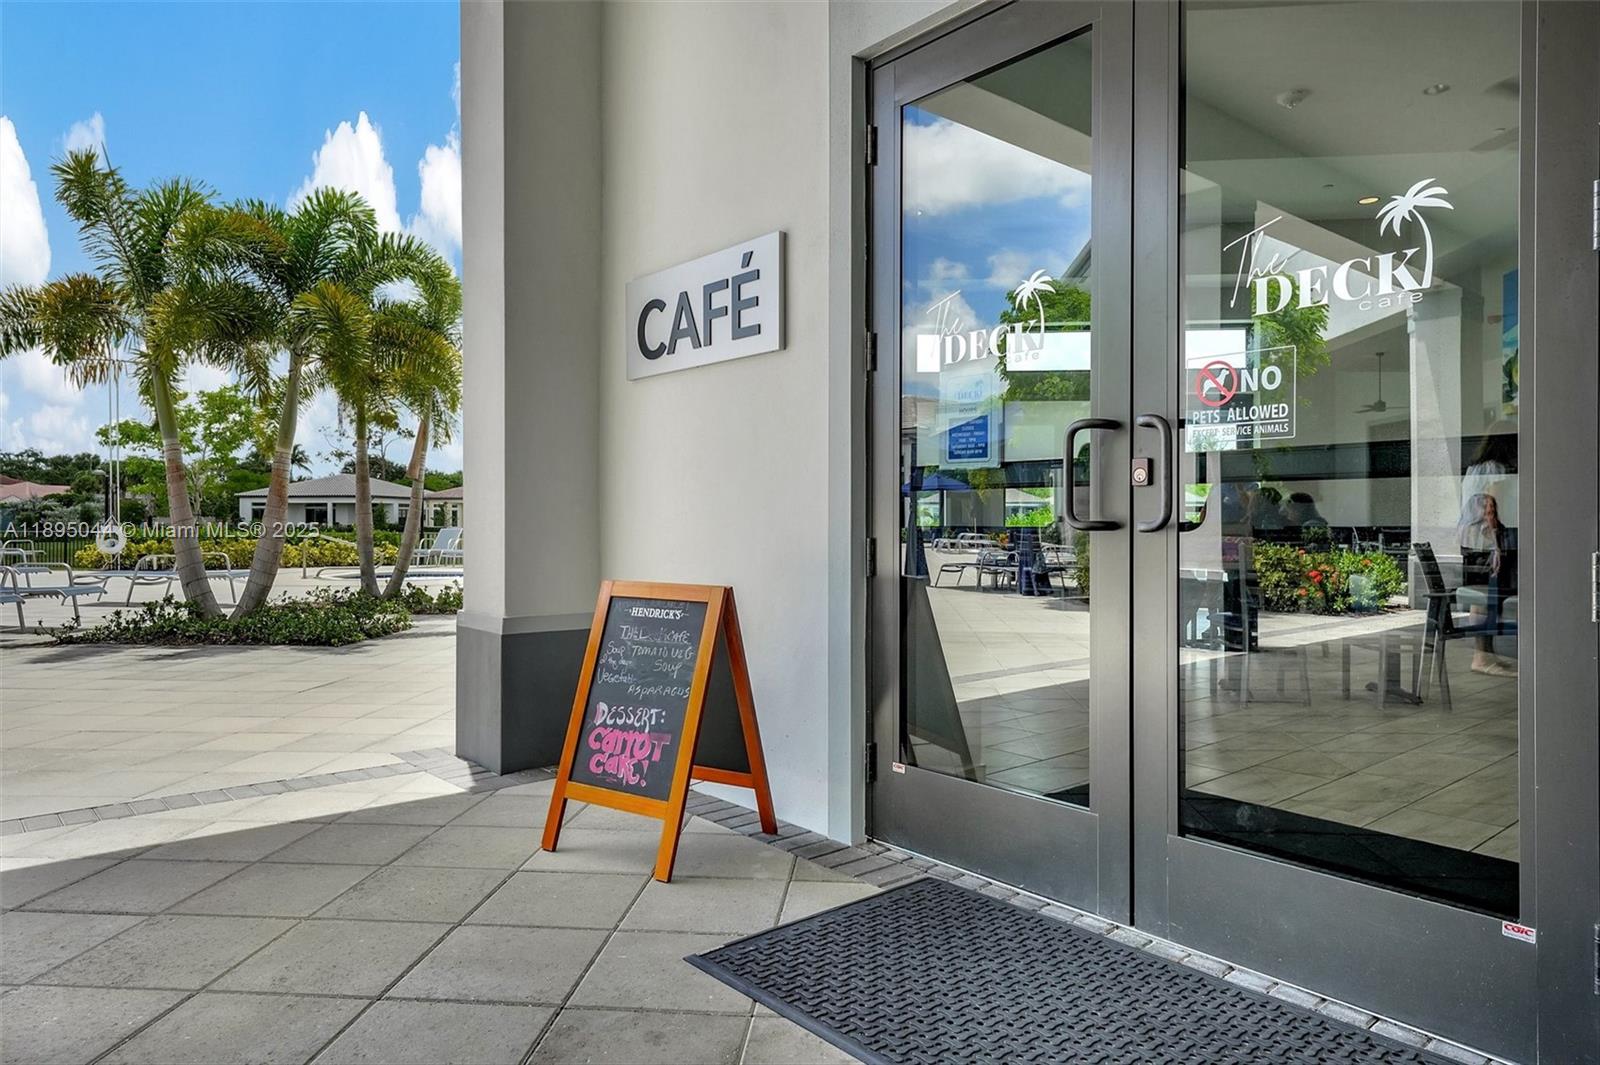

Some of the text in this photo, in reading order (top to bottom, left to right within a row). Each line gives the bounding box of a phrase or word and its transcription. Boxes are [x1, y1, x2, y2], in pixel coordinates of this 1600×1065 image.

[1223, 216, 1289, 308] The
[1250, 248, 1422, 316] DECK
[637, 250, 761, 360] CAFÉ
[1359, 291, 1423, 310] cafe
[926, 289, 964, 352] The
[944, 319, 1041, 365] DECK
[1240, 365, 1282, 392] NO
[1192, 403, 1289, 424] PETS ALLOWED
[1222, 426, 1252, 436] SERVICE
[1253, 423, 1289, 434] ANIMALS
[631, 606, 681, 620] HENDRICK'S
